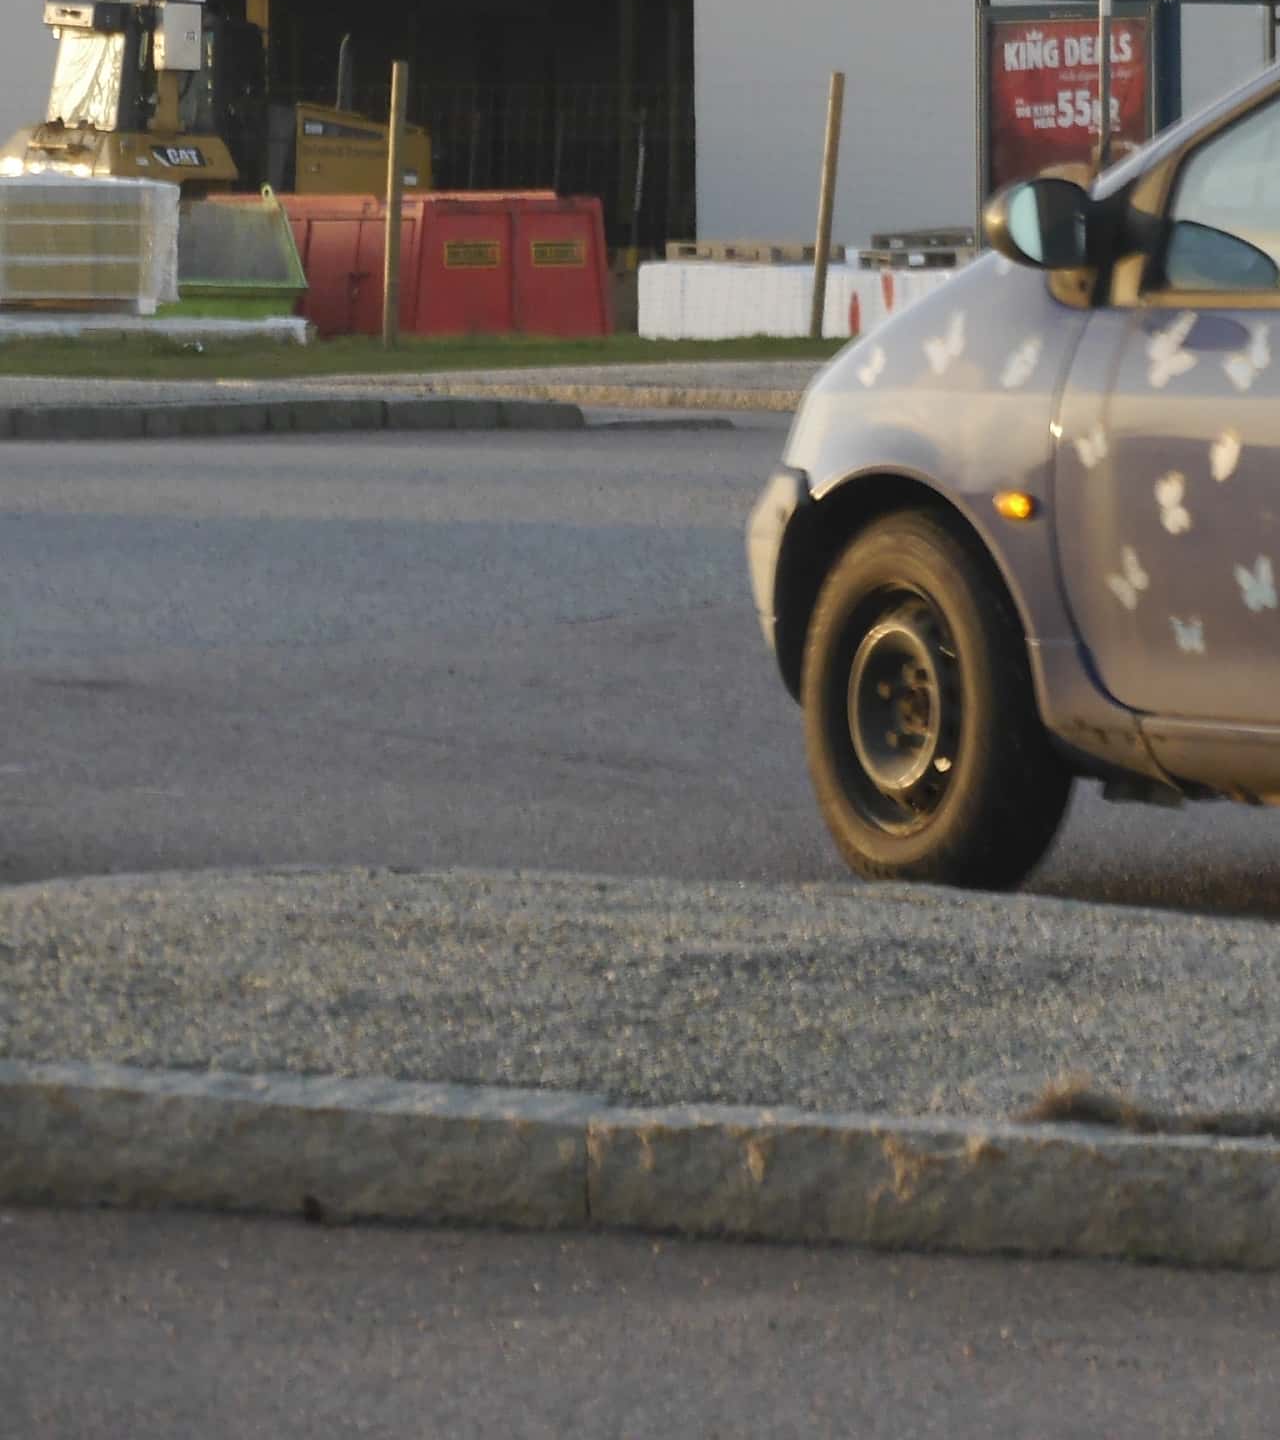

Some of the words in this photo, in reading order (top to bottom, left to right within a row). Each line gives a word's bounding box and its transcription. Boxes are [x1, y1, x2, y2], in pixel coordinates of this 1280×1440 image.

[1004, 37, 1059, 71] KING
[1057, 89, 1091, 128] 55
[166, 147, 200, 165] CAT
